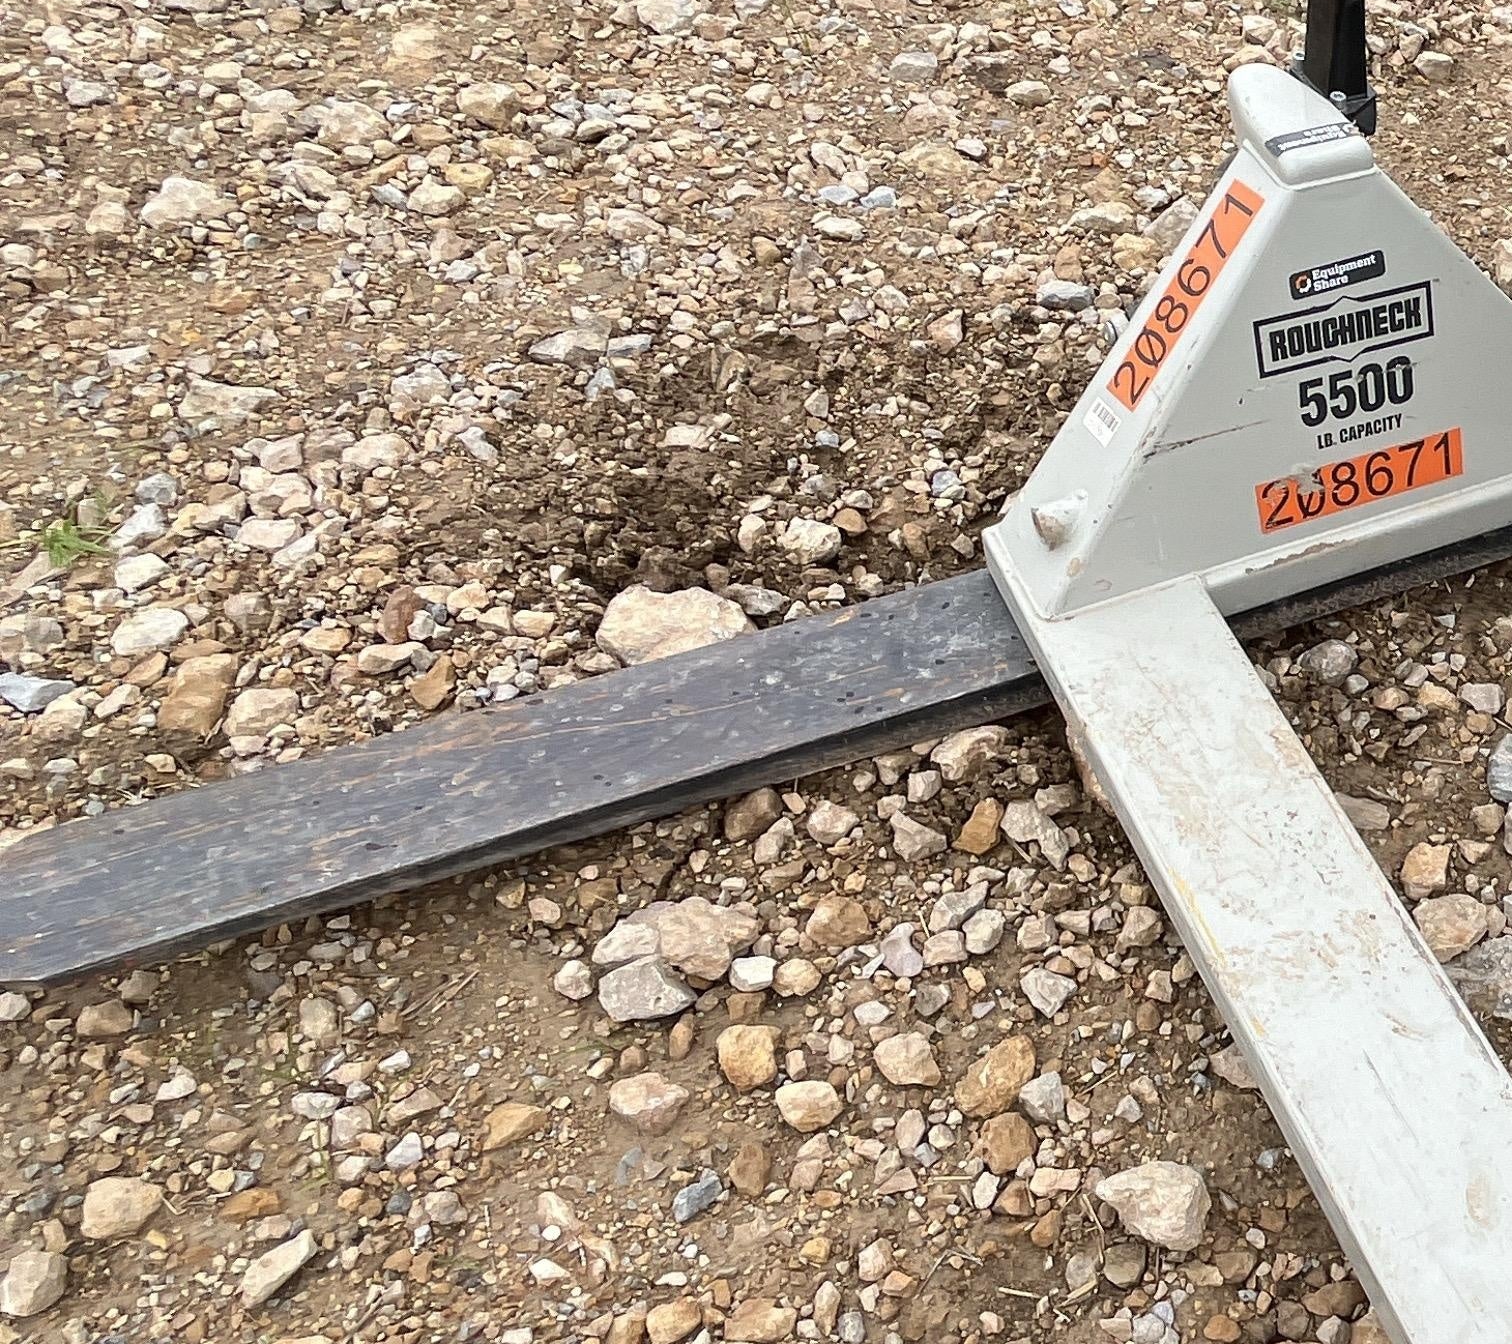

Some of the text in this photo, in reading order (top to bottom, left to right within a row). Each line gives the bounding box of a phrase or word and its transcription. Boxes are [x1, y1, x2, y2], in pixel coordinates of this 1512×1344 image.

[1312, 255, 1376, 280] Equipment
[1313, 274, 1349, 292] Share
[1113, 192, 1254, 406] 208671
[1269, 297, 1423, 362] ROUGHNECK
[1299, 356, 1414, 427] 5500
[1317, 413, 1402, 450] LB. CAPACITY
